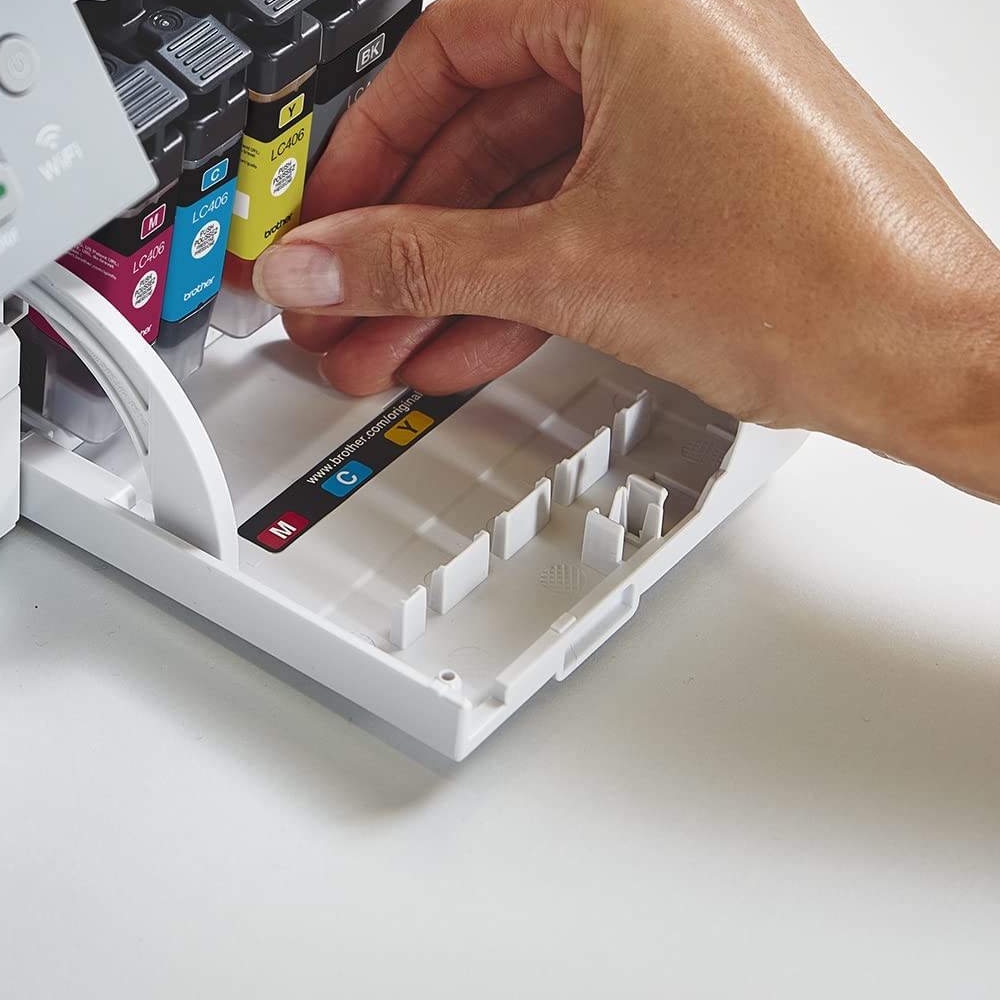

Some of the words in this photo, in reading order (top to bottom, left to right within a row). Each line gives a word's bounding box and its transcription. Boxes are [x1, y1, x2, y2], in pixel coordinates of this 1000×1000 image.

[361, 41, 380, 66] BK
[287, 104, 297, 118] Y
[271, 128, 305, 161] LC406
[210, 168, 220, 181] C
[192, 192, 229, 224] LC406
[148, 213, 159, 231] M
[264, 212, 293, 239] brother
[133, 241, 165, 274] LC406
[183, 276, 216, 301] brother
[306, 390, 423, 485] www.brother.com/original
[268, 520, 297, 539] M
[336, 470, 358, 485] C
[397, 420, 418, 434] Y
